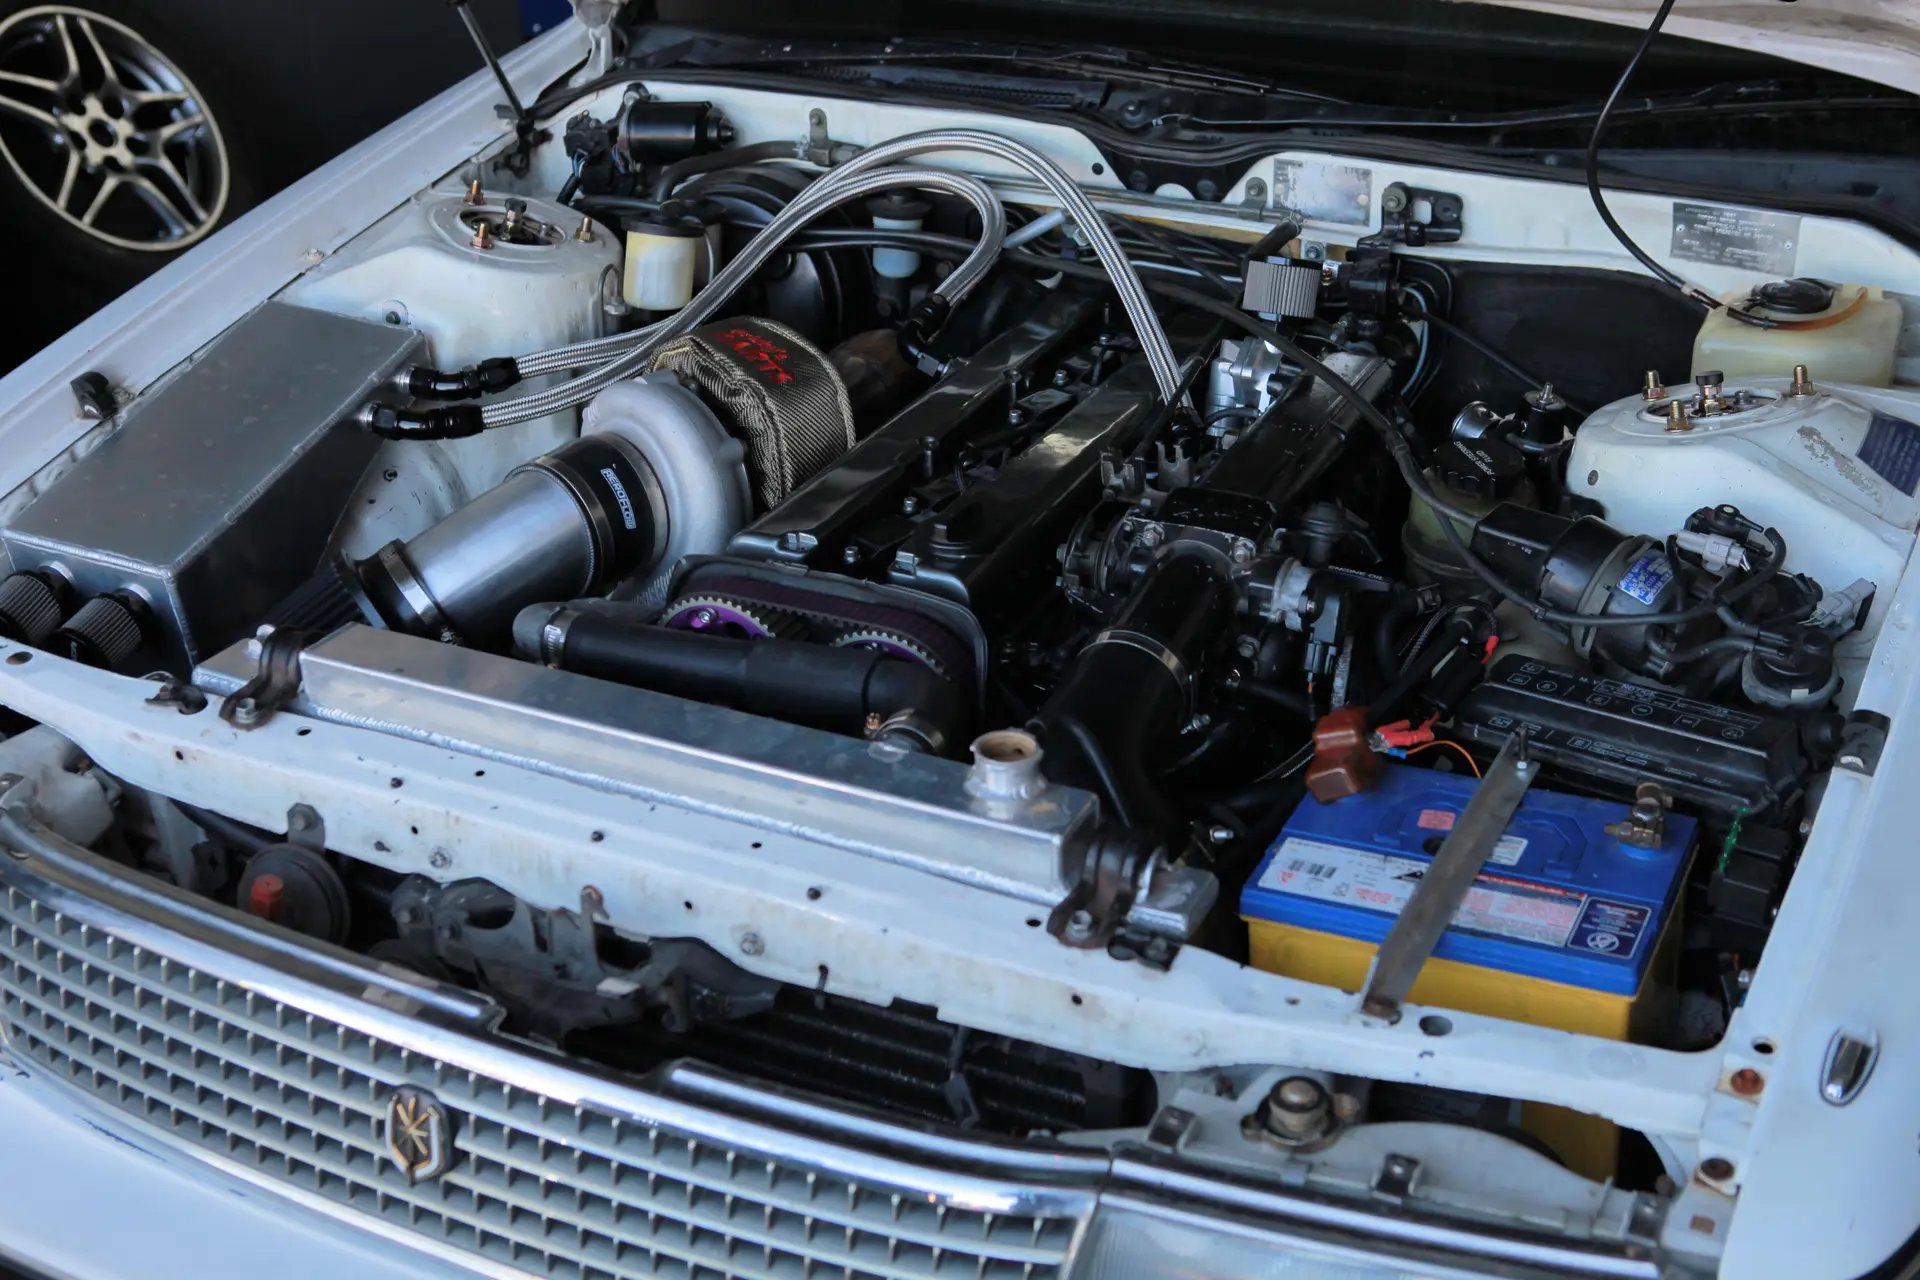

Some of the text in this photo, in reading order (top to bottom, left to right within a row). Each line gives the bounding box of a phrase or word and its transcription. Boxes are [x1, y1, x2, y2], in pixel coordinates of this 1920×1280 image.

[1454, 441, 1495, 475] POWER STEERING
[1476, 450, 1493, 463] FLUID
[601, 468, 636, 529] AEROFLOW
